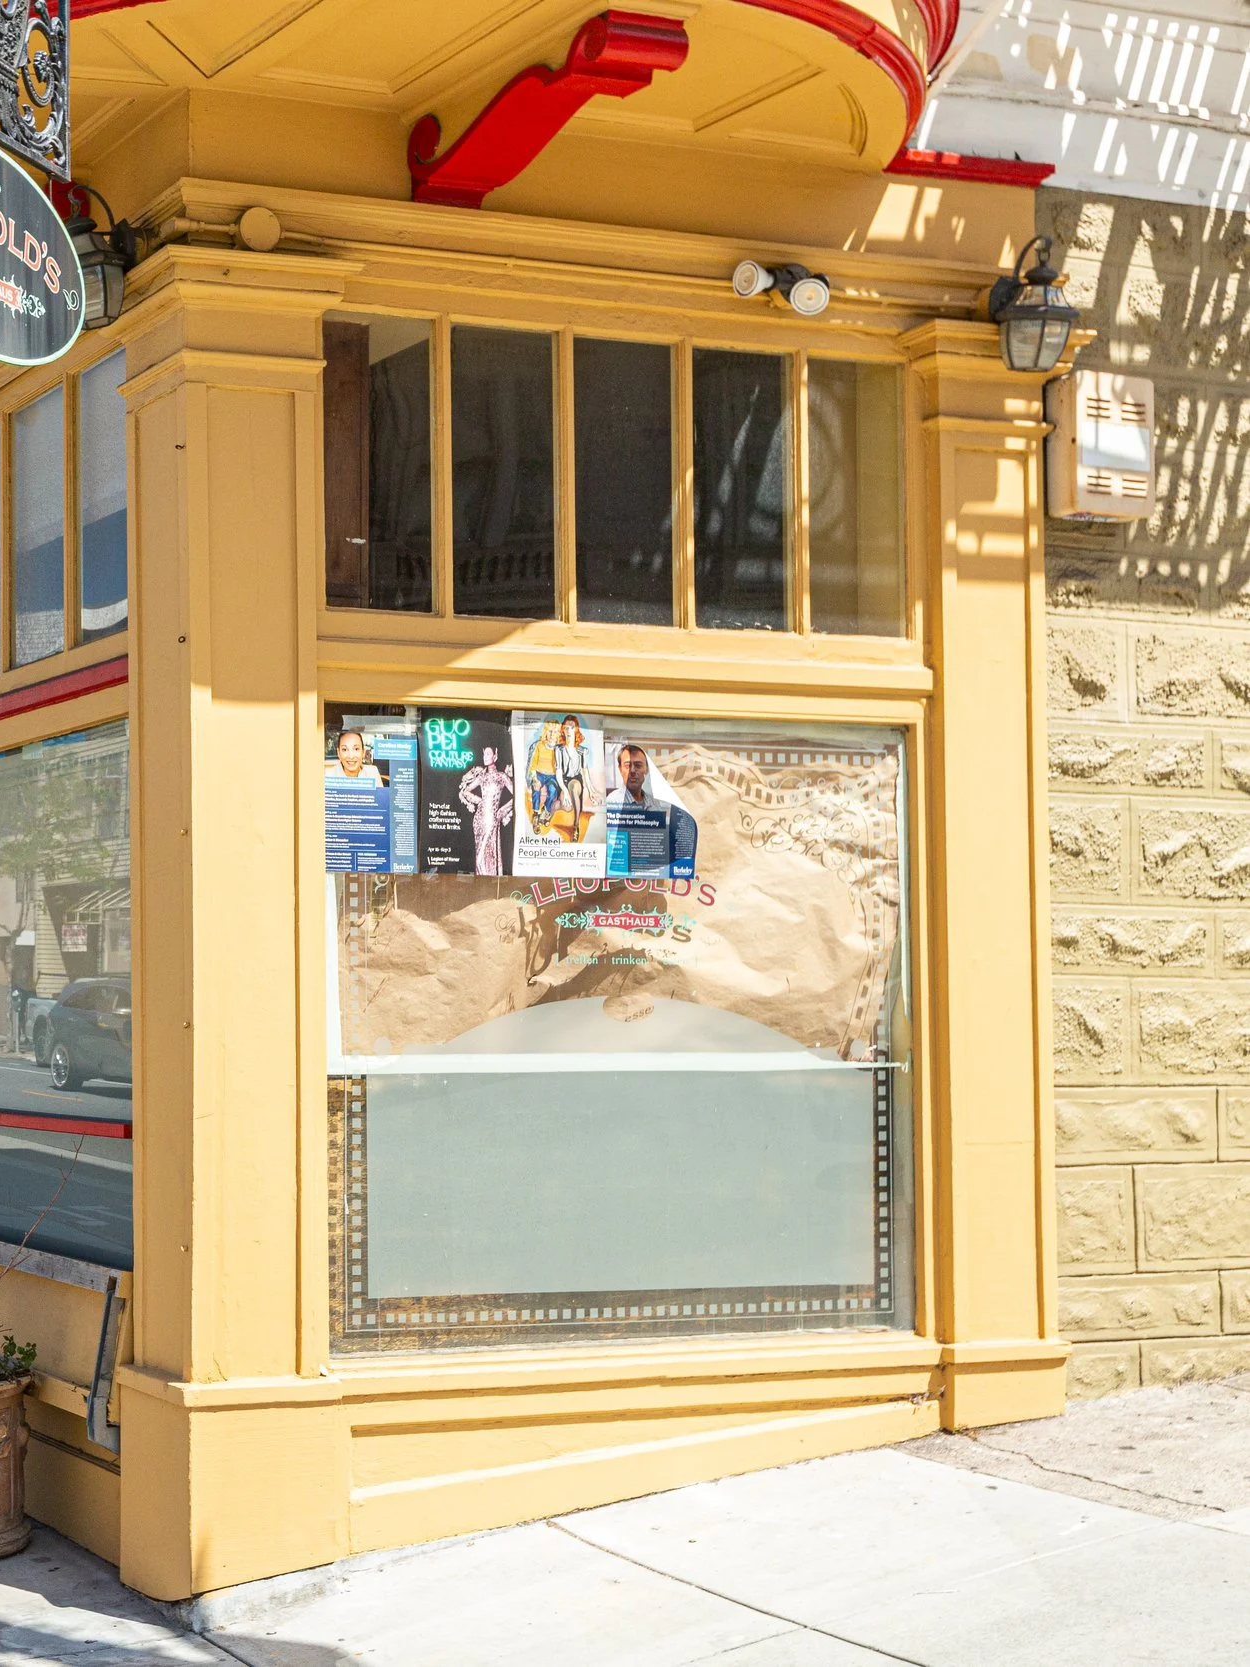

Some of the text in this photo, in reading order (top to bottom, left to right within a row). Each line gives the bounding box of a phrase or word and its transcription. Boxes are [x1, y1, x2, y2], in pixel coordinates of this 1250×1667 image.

[425, 718, 470, 736] GUO
[428, 733, 457, 750] PEI
[429, 750, 474, 761] COUTURE
[430, 758, 467, 769] FANTASY
[519, 836, 561, 846] Alice Neel
[518, 848, 597, 859] People Come First
[598, 917, 655, 927] GASTHAUS
[611, 952, 647, 966] trinken
